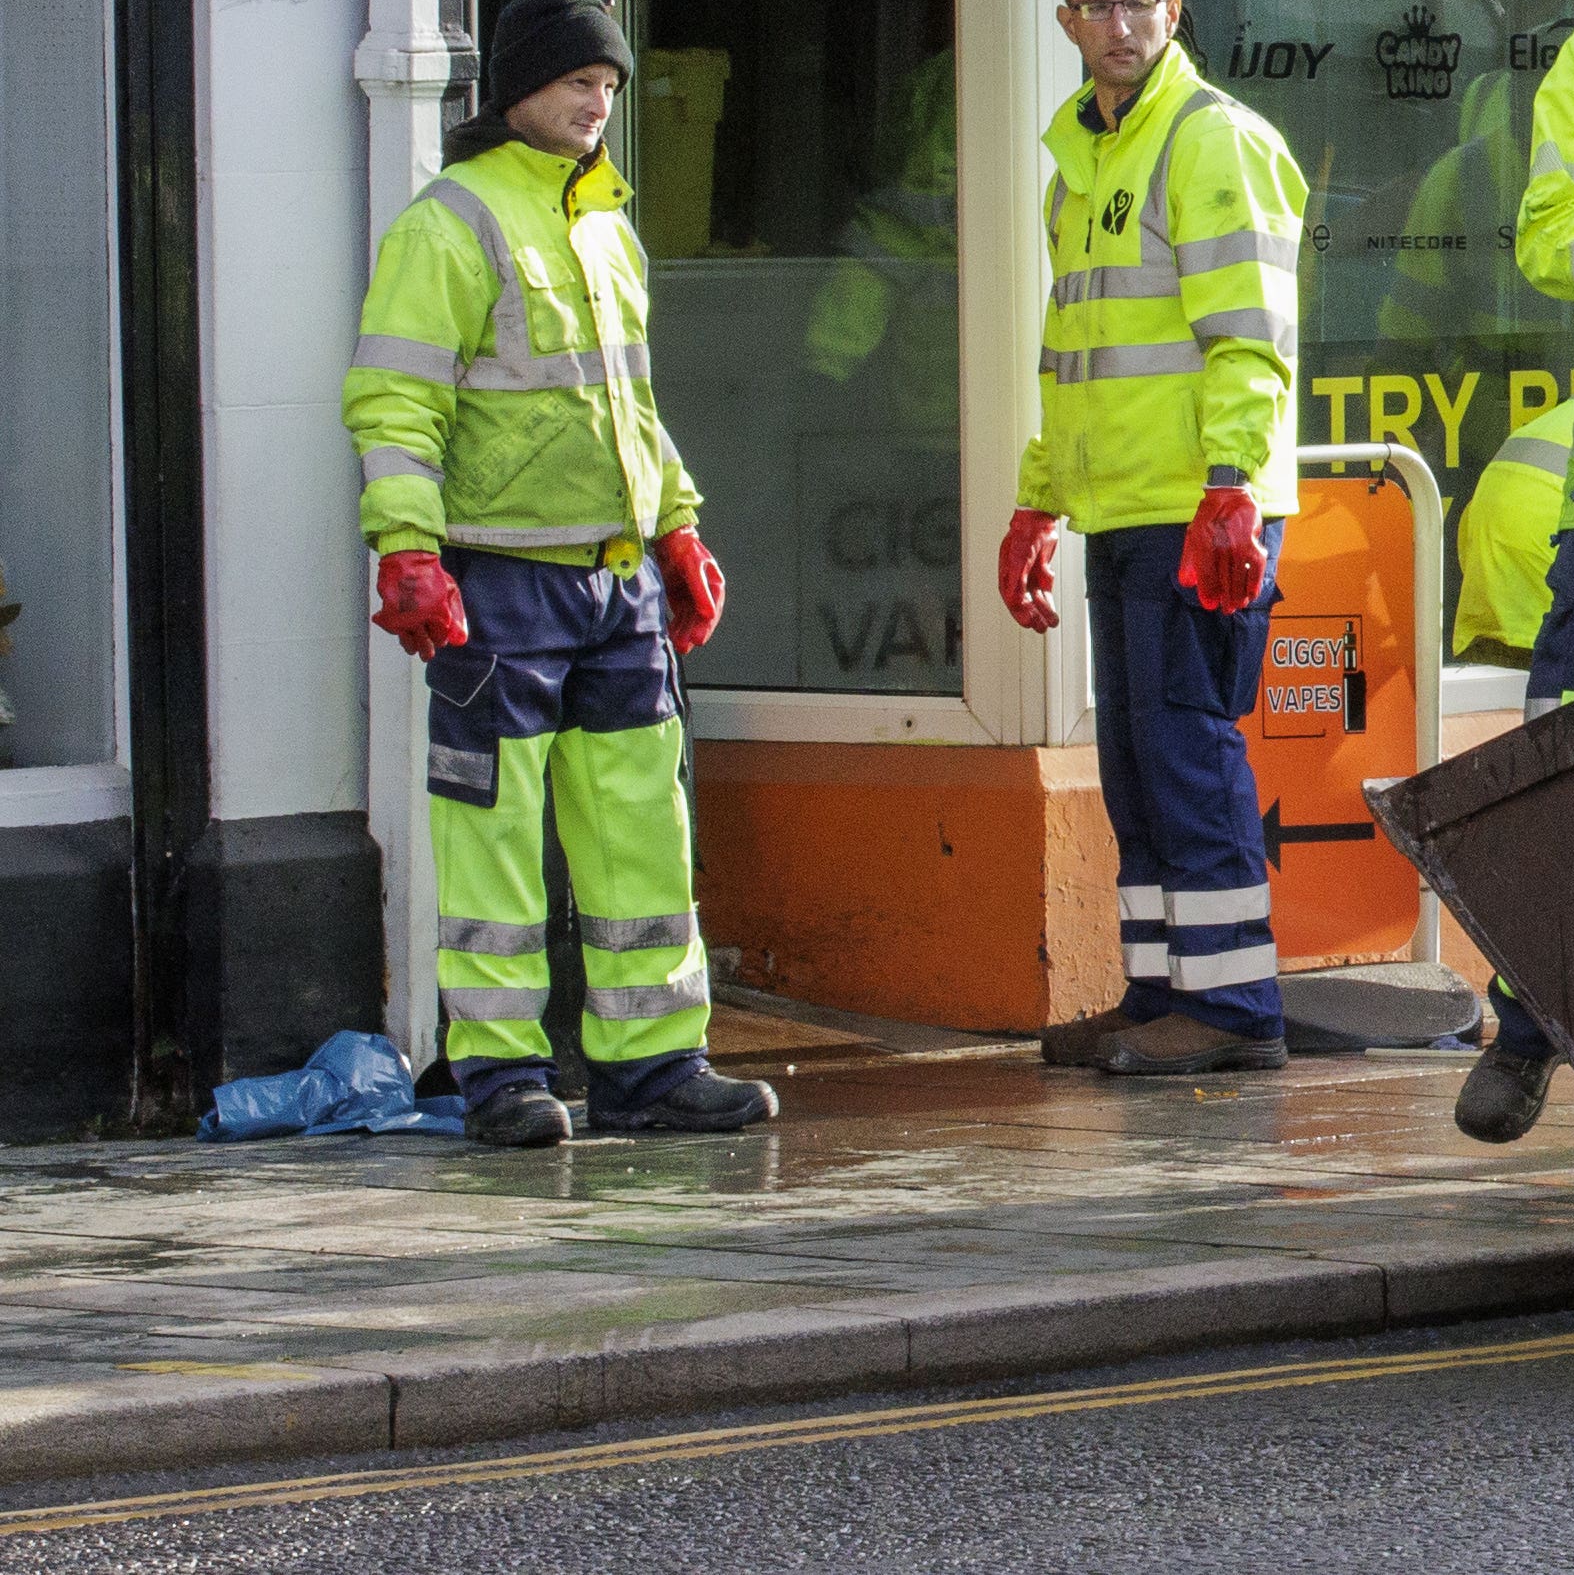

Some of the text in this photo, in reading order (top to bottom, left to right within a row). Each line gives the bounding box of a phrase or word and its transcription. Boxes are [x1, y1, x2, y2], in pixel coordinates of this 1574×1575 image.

[1367, 235, 1467, 250] NITECORE
[1312, 372, 1481, 473] TRY
[1271, 637, 1344, 668] CIGGY
[1267, 685, 1343, 714] VAPES
